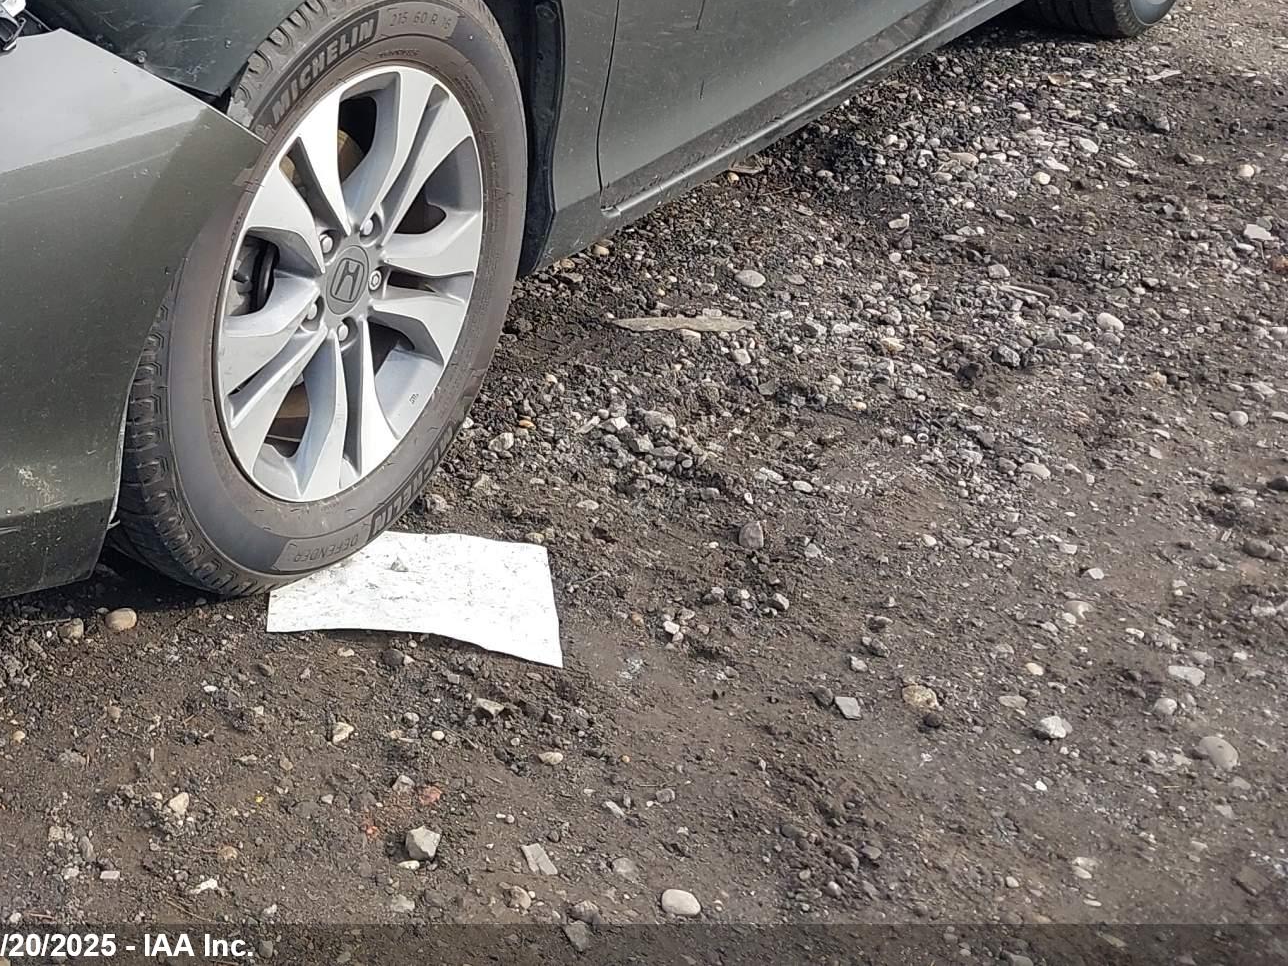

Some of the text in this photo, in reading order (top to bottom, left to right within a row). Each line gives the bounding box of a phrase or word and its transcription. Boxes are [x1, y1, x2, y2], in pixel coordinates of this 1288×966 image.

[390, 11, 409, 27] 215
[414, 10, 428, 24] 60
[431, 13, 439, 25] R
[271, 18, 375, 125] MICHELIN
[372, 424, 455, 536] MICHELIN
[294, 534, 359, 562] DEFENDER
